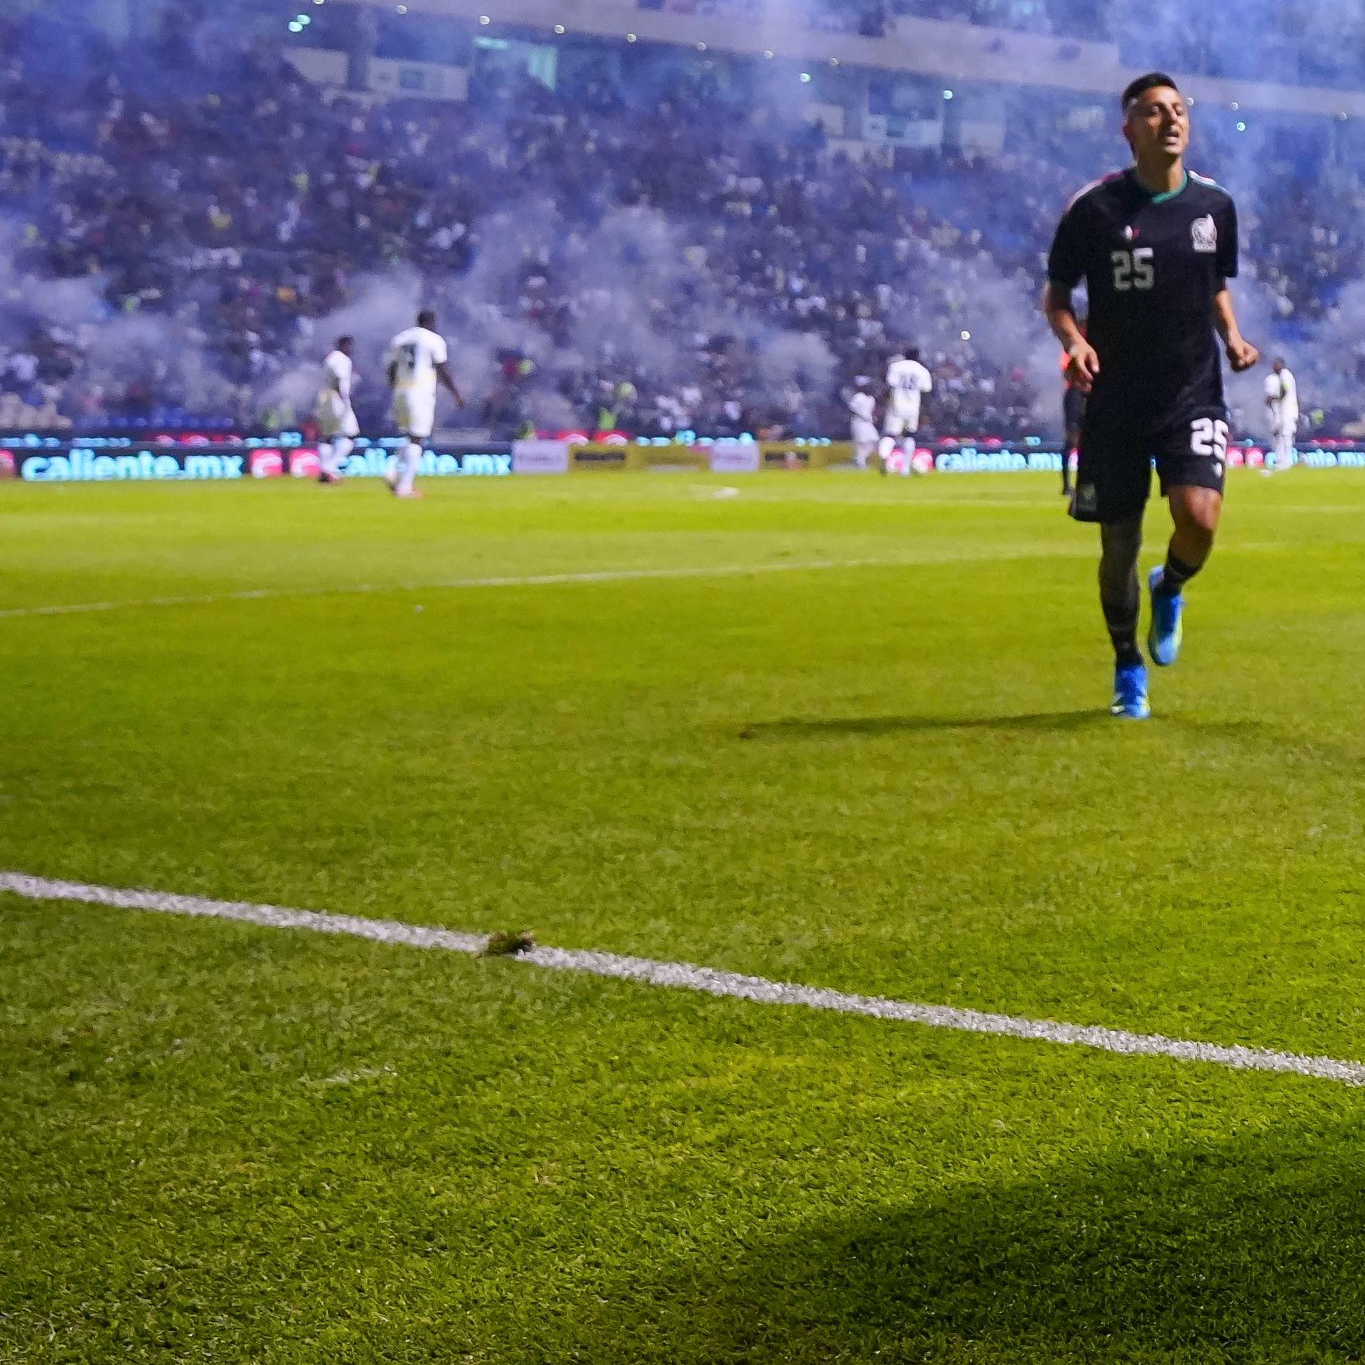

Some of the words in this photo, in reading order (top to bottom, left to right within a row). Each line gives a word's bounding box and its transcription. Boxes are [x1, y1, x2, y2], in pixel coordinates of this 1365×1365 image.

[1111, 247, 1154, 290] 25
[1190, 417, 1228, 460] 25
[21, 448, 244, 482] caliente.mx
